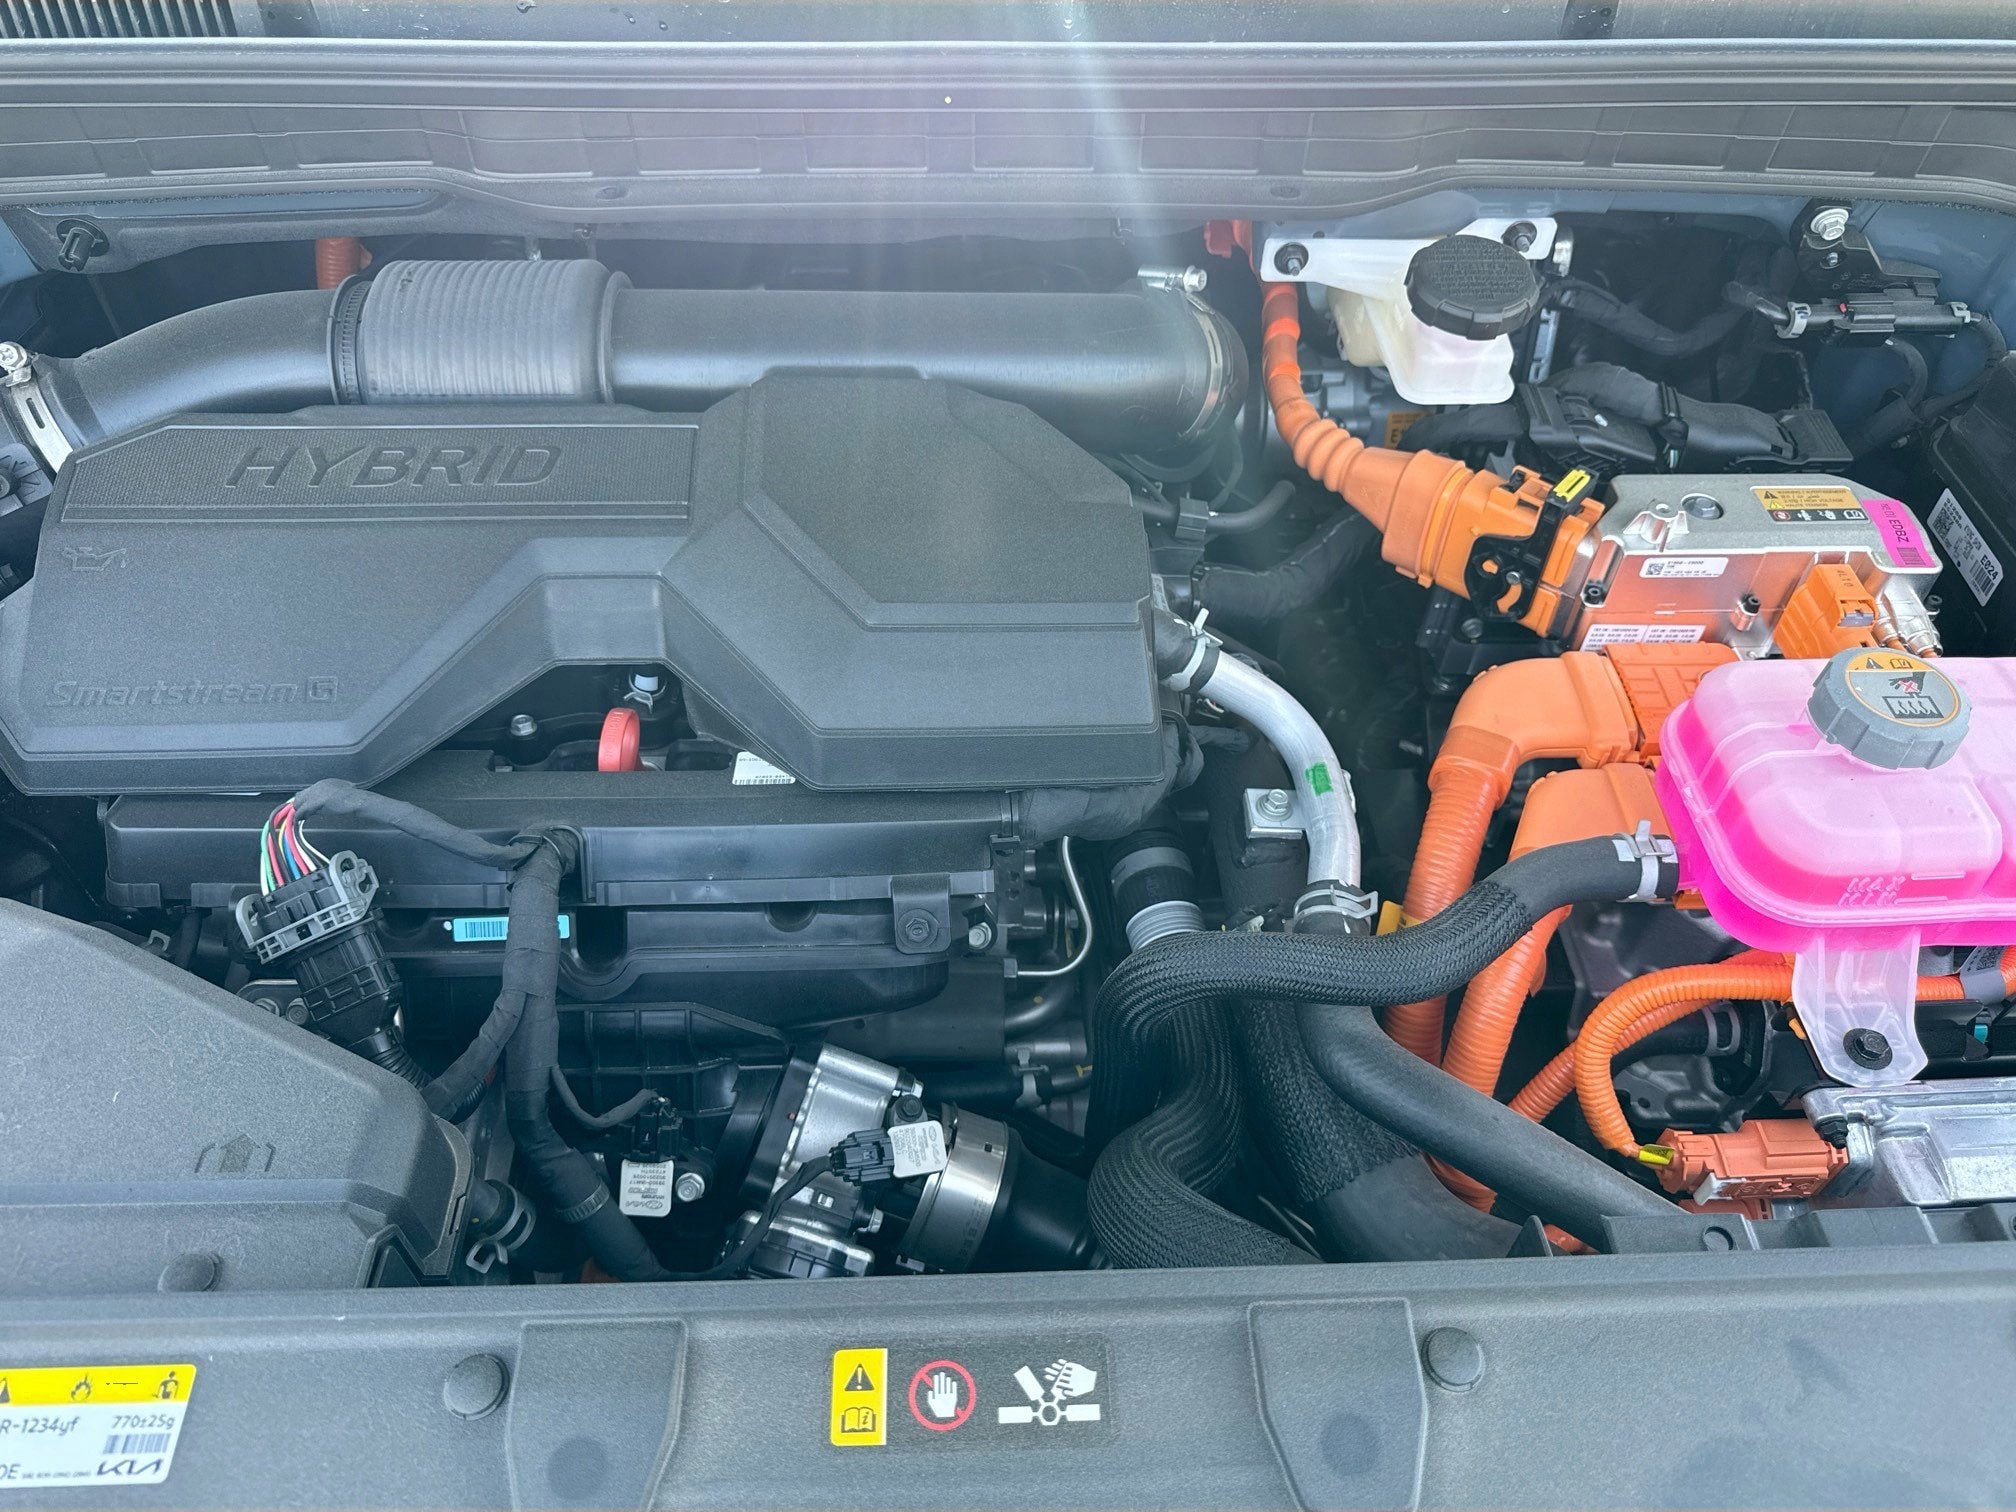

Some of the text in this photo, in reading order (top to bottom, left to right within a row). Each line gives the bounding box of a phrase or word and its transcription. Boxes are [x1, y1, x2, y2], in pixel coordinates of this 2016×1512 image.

[225, 445, 562, 488] HYBRID
[1980, 554, 1999, 581] E024
[46, 679, 299, 706] Smartstream
[1845, 876, 1906, 893] MAX
[0, 1416, 80, 1436] R-1234yf
